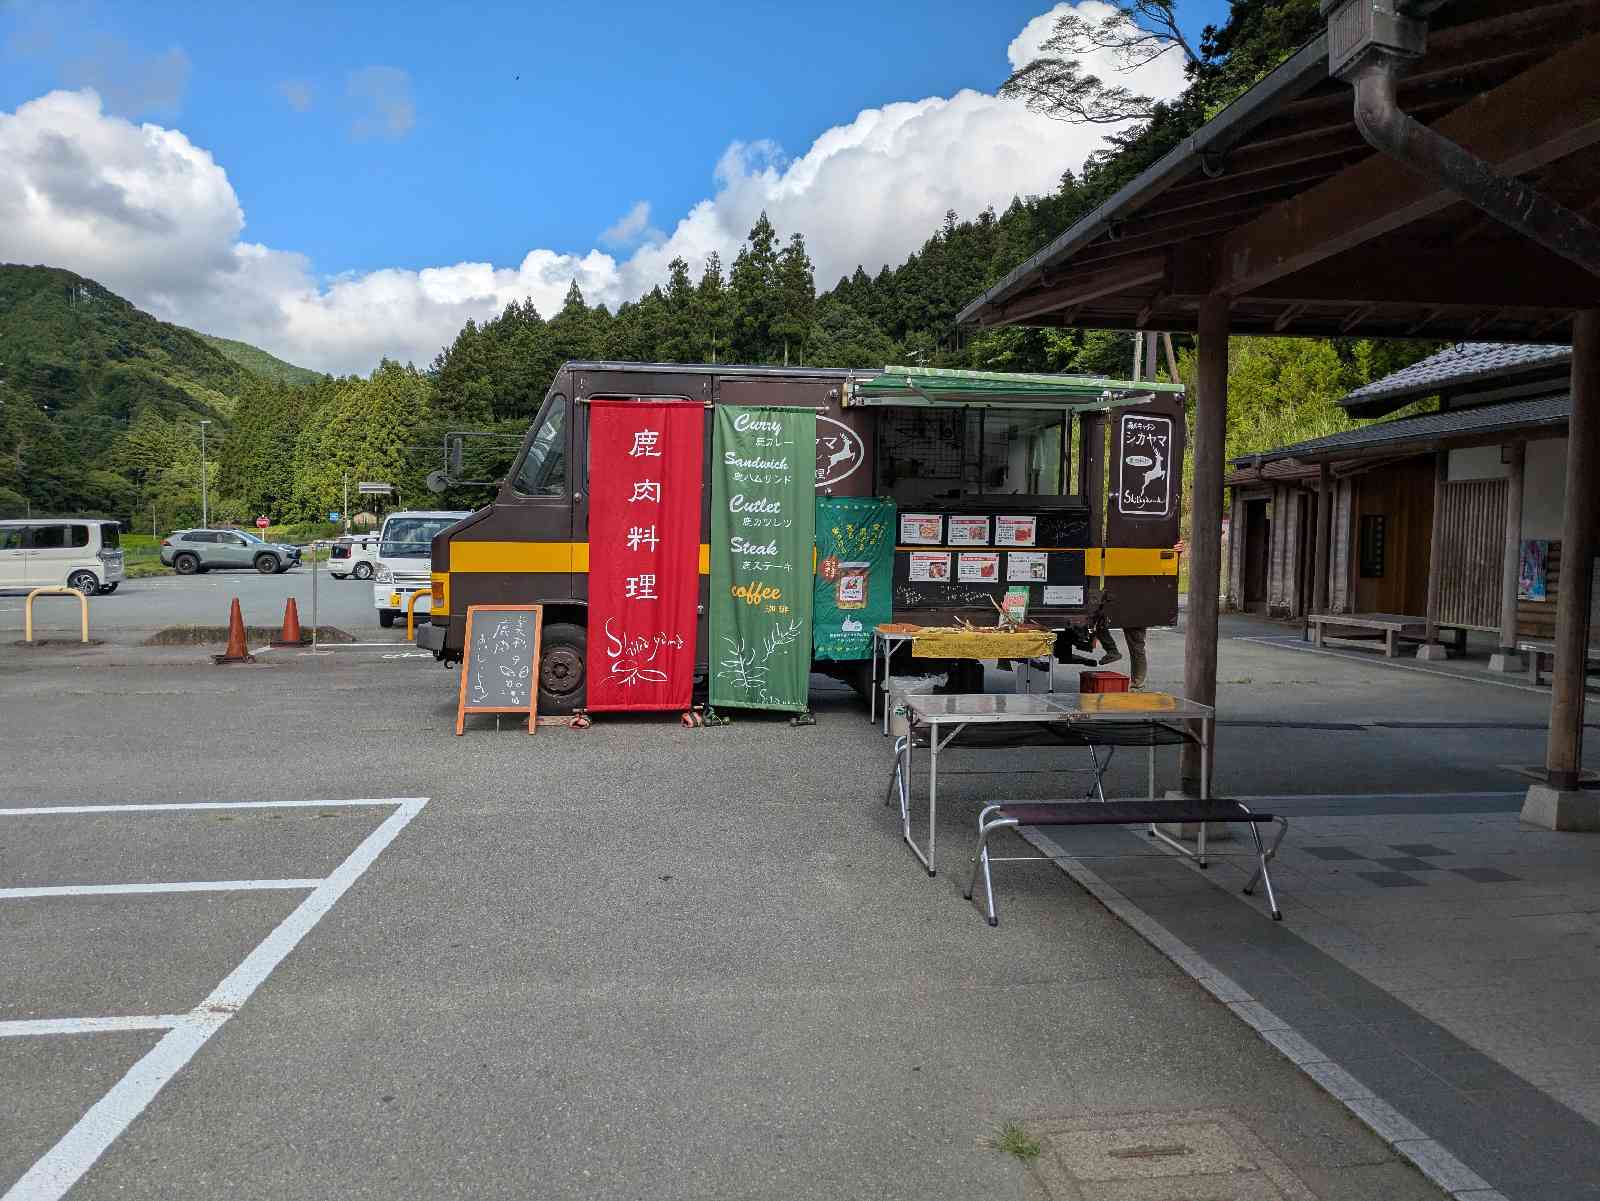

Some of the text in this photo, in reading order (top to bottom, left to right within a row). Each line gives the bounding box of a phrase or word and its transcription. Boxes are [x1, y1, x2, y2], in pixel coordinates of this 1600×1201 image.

[734, 413, 782, 436] Curry
[1125, 431, 1168, 447] シカヤマ
[725, 451, 790, 470] Sandwich
[729, 494, 781, 513] Cutlet
[624, 429, 661, 600] 鹿肉料理
[730, 536, 780, 555] Steak
[731, 580, 782, 606] coffee
